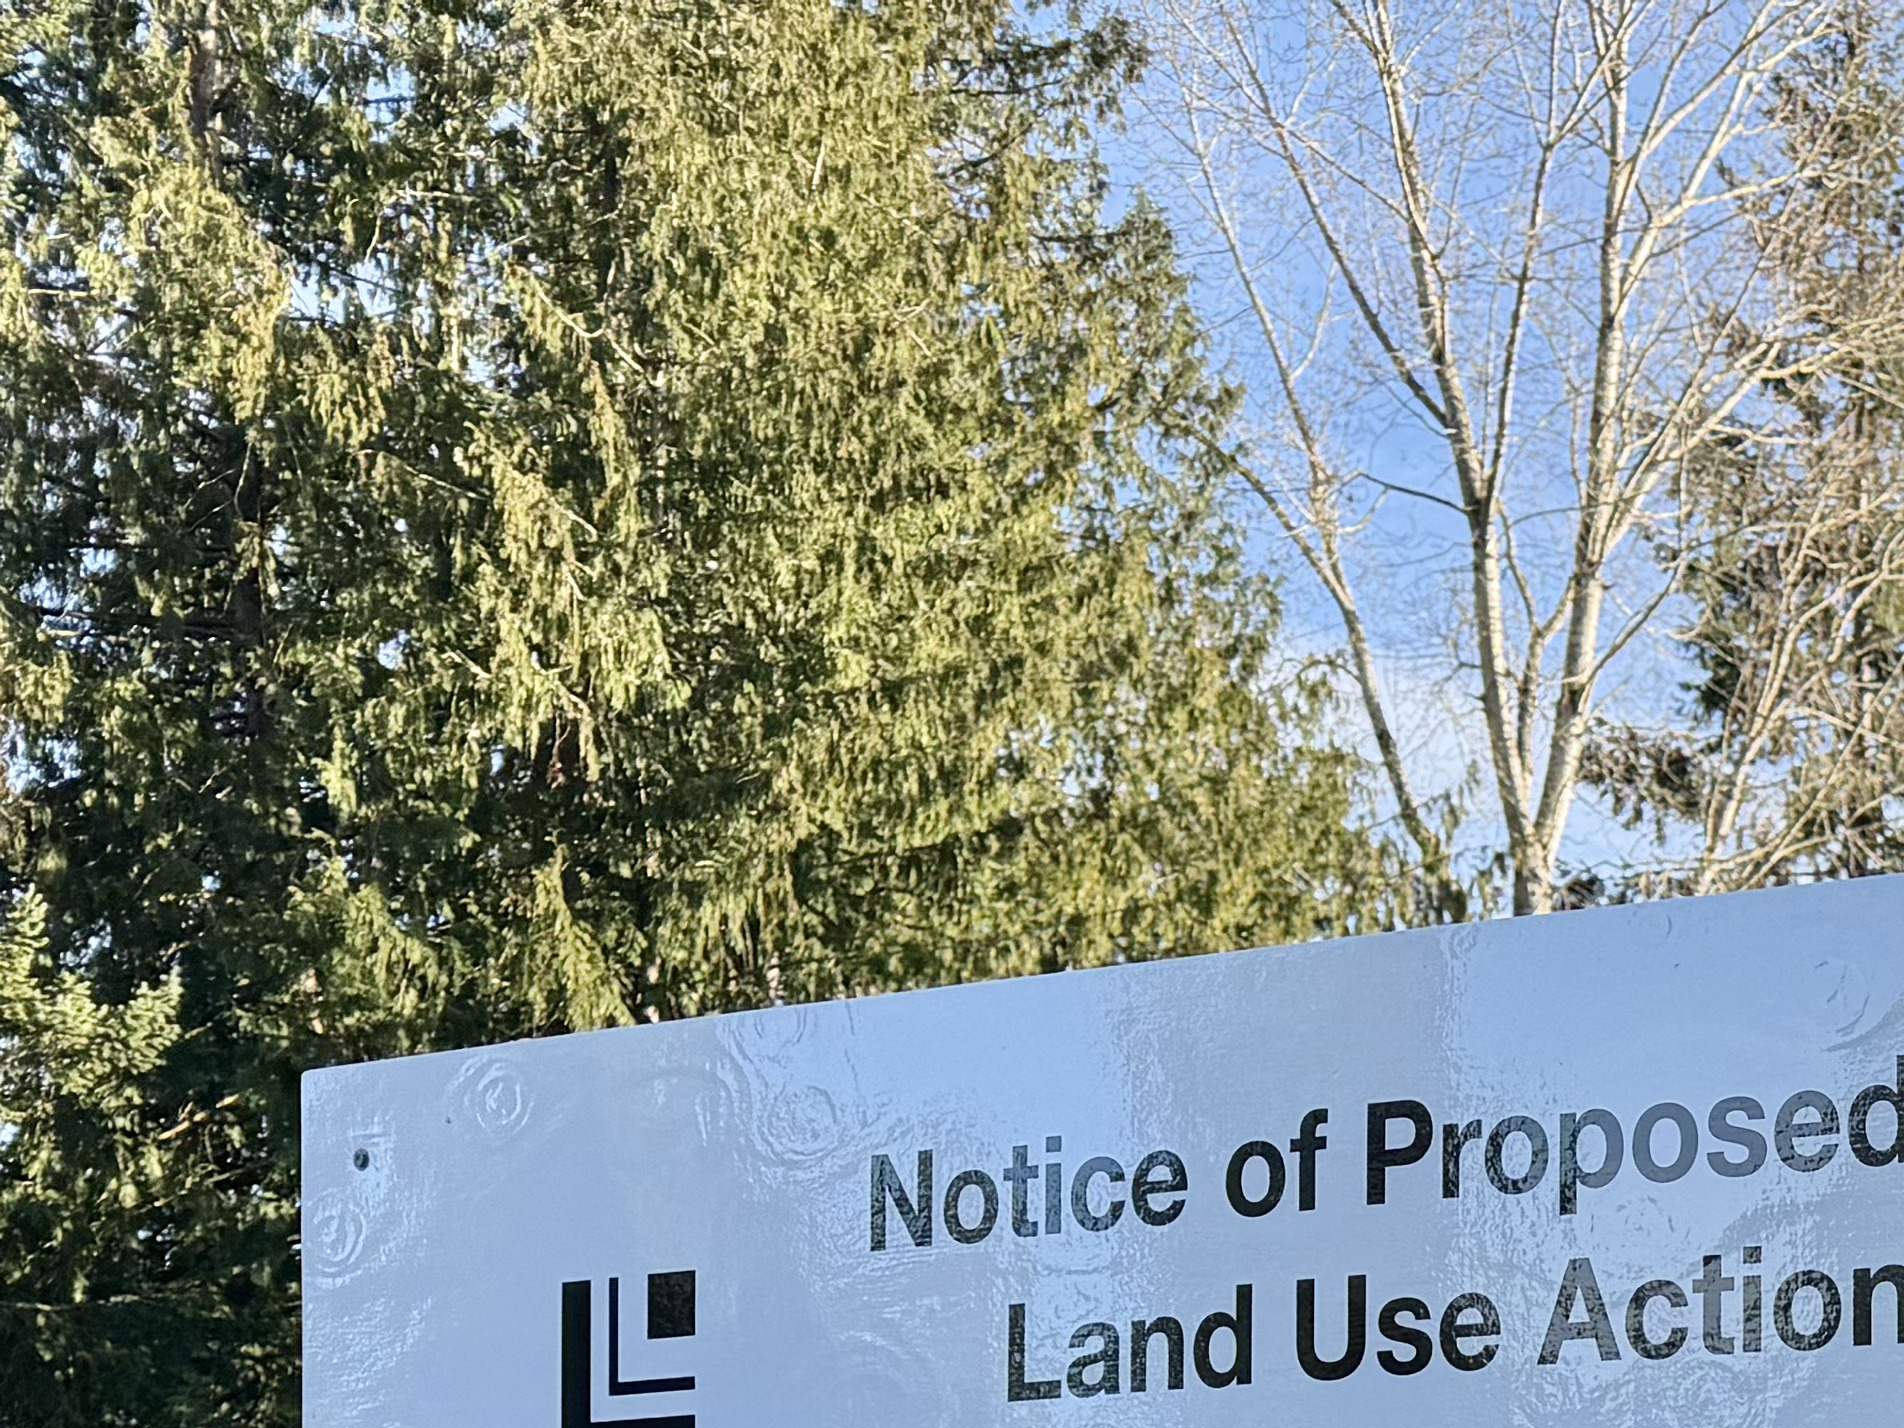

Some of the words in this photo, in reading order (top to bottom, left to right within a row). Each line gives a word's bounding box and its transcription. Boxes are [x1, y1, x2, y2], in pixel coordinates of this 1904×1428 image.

[869, 1135, 1189, 1253] Notice
[1225, 1107, 1329, 1218] of
[1007, 1283, 1253, 1403] Land
[1295, 1274, 1502, 1382] Use
